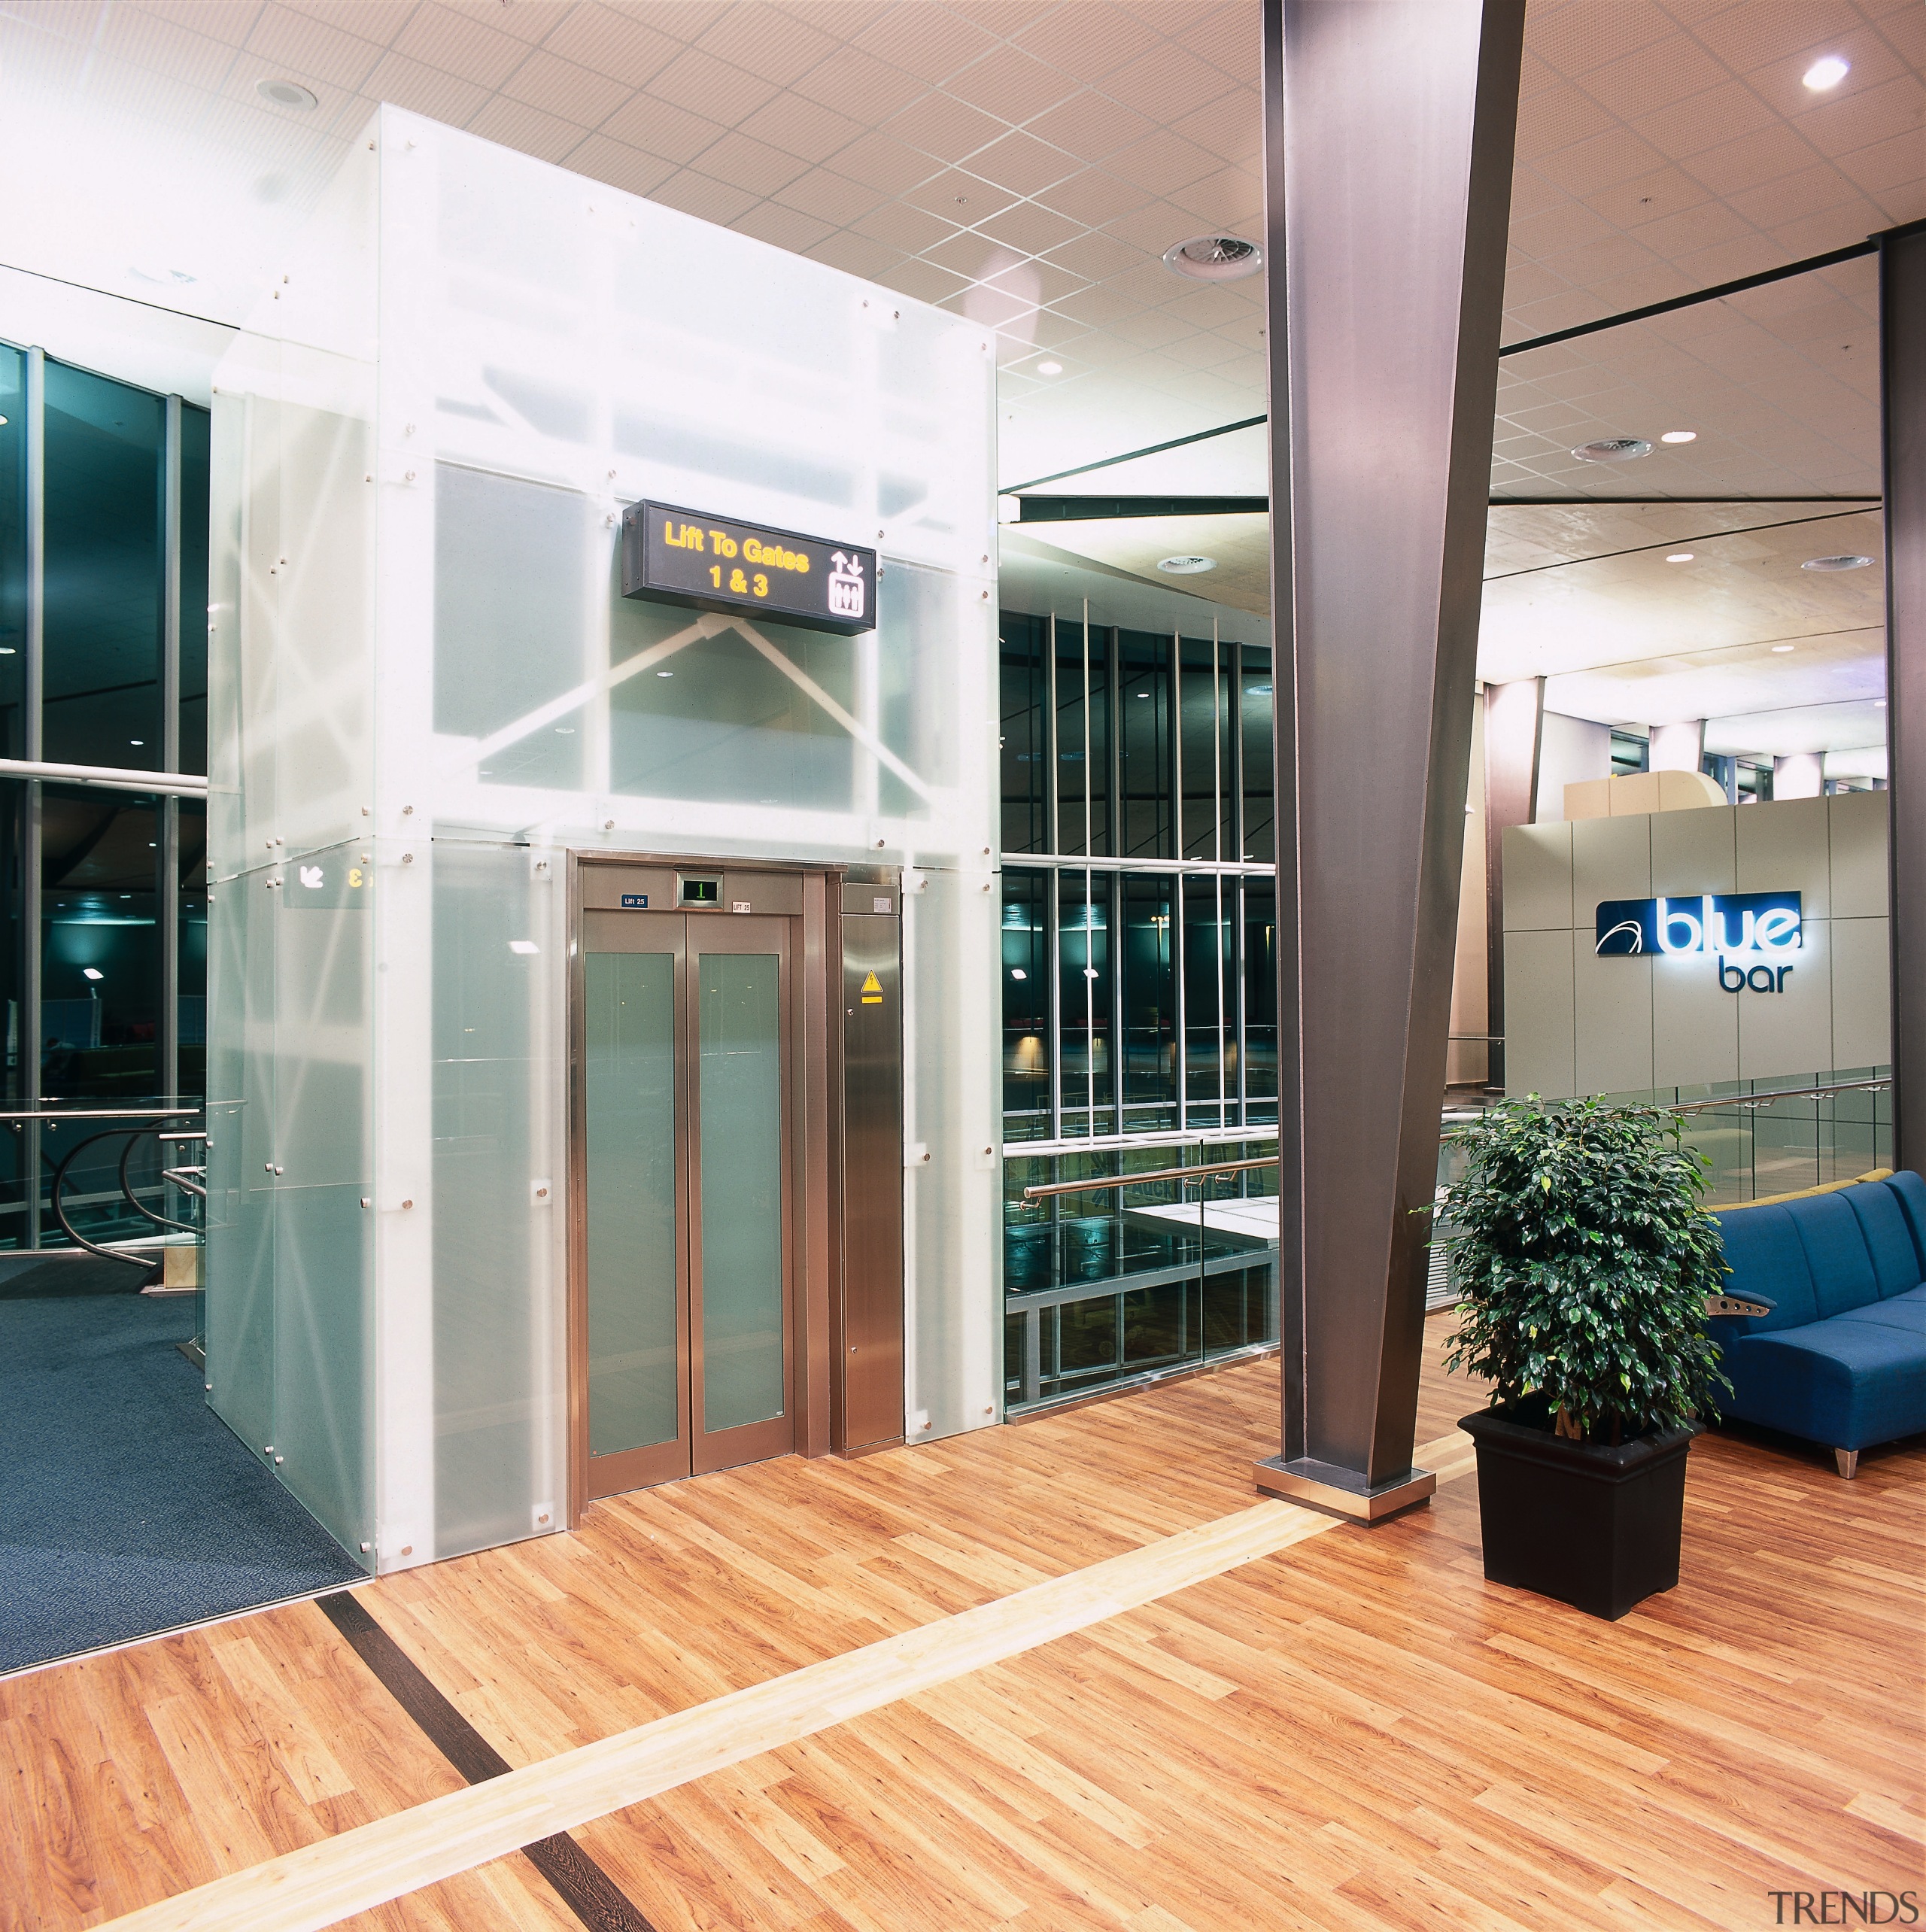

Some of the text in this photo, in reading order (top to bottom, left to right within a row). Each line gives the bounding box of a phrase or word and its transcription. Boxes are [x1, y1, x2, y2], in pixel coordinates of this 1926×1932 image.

[664, 521, 810, 573] Lift To Gates
[709, 565, 768, 597] 1 & 3
[696, 882, 706, 898] 1
[1656, 894, 1802, 956] blue
[1718, 955, 1794, 993] bar
